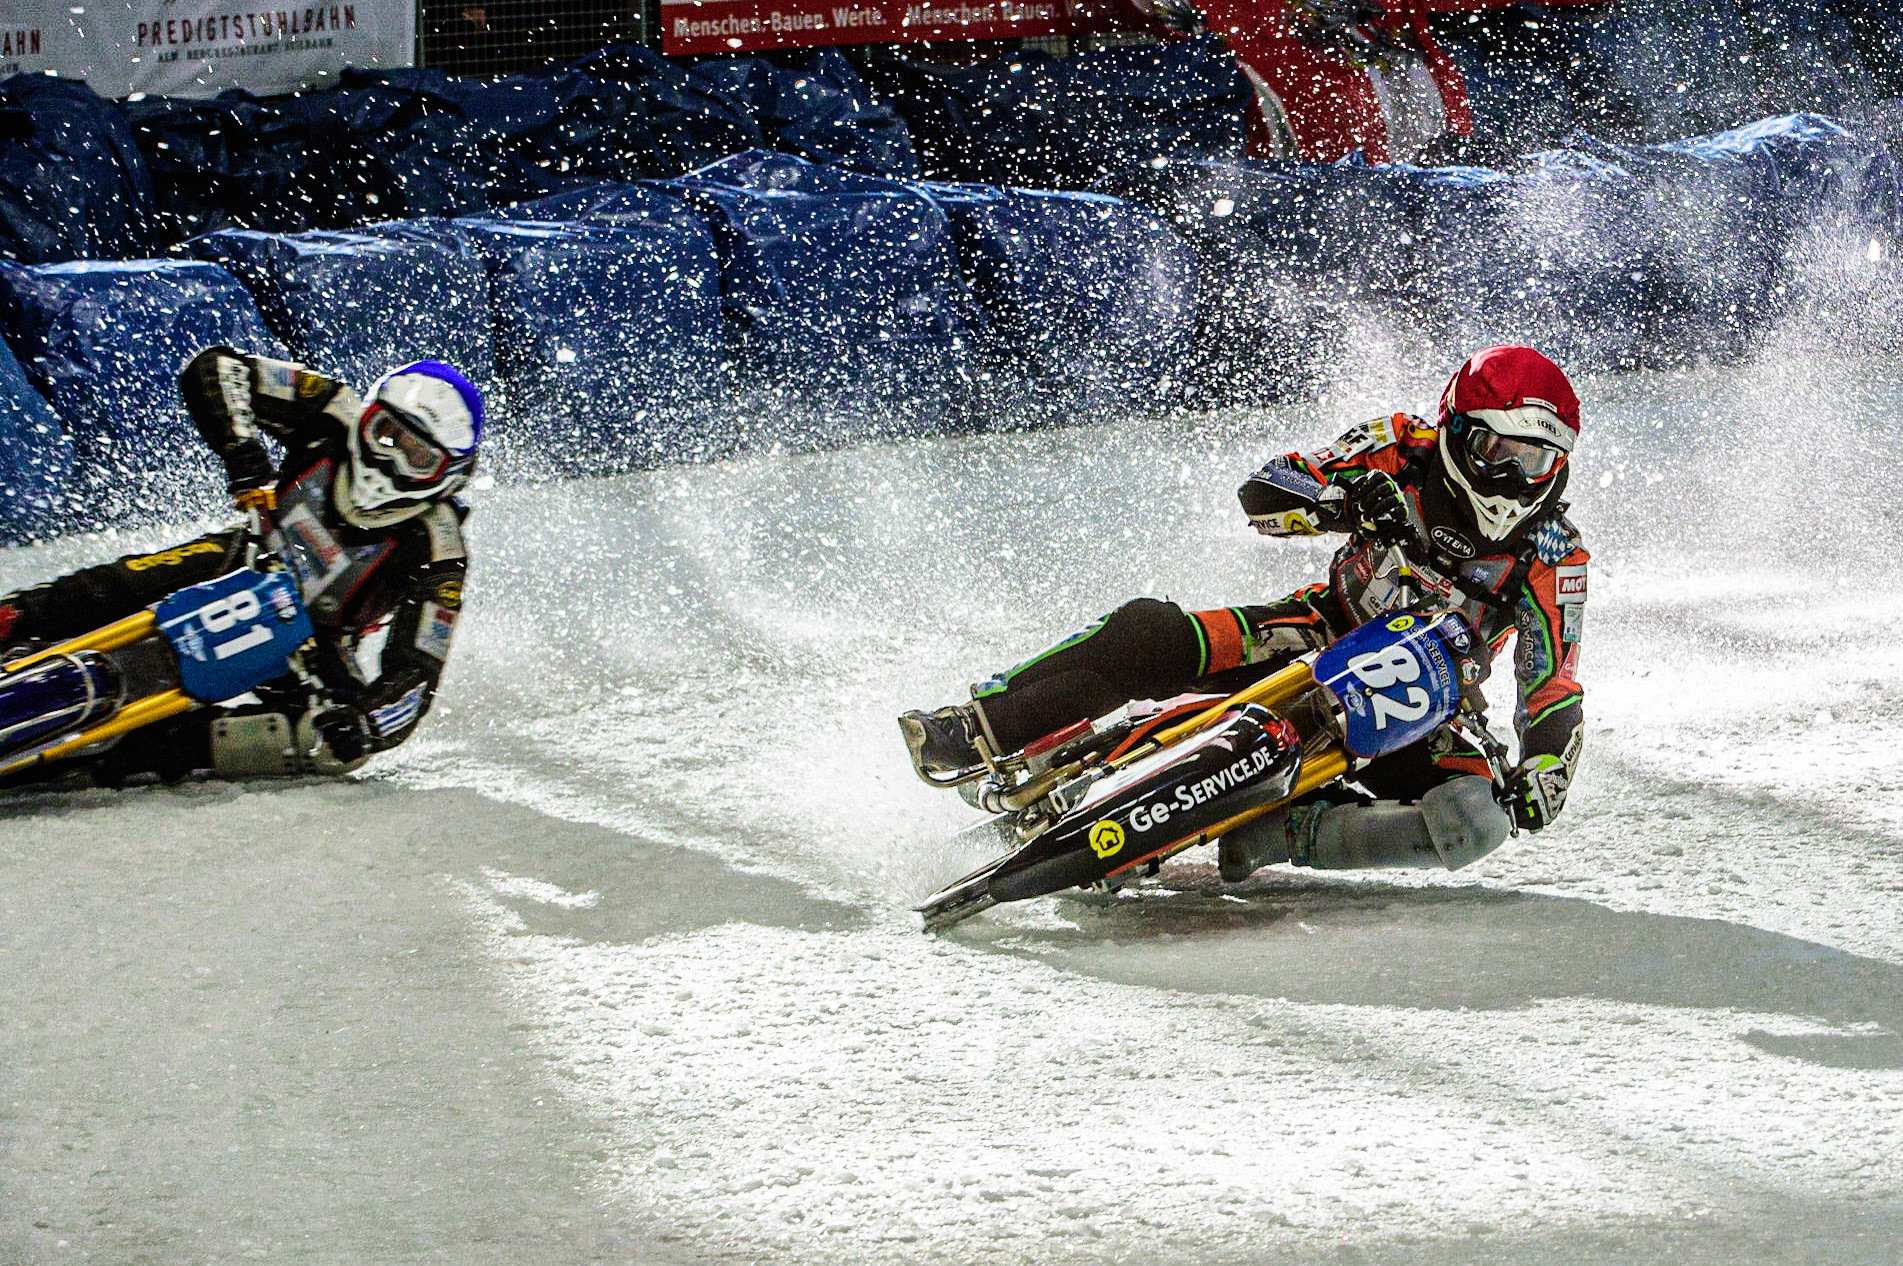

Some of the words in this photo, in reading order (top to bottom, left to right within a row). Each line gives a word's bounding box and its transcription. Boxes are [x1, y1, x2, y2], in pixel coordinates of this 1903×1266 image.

[137, 5, 357, 46] PREDIGTSTUHLBAHN
[673, 14, 766, 37] Menschen.
[771, 10, 829, 32] Bauen.
[832, 7, 887, 28] Werte.
[199, 589, 275, 661] 81
[1347, 645, 1430, 730] 82
[1129, 746, 1274, 832] Ge-SERVICE.DE
